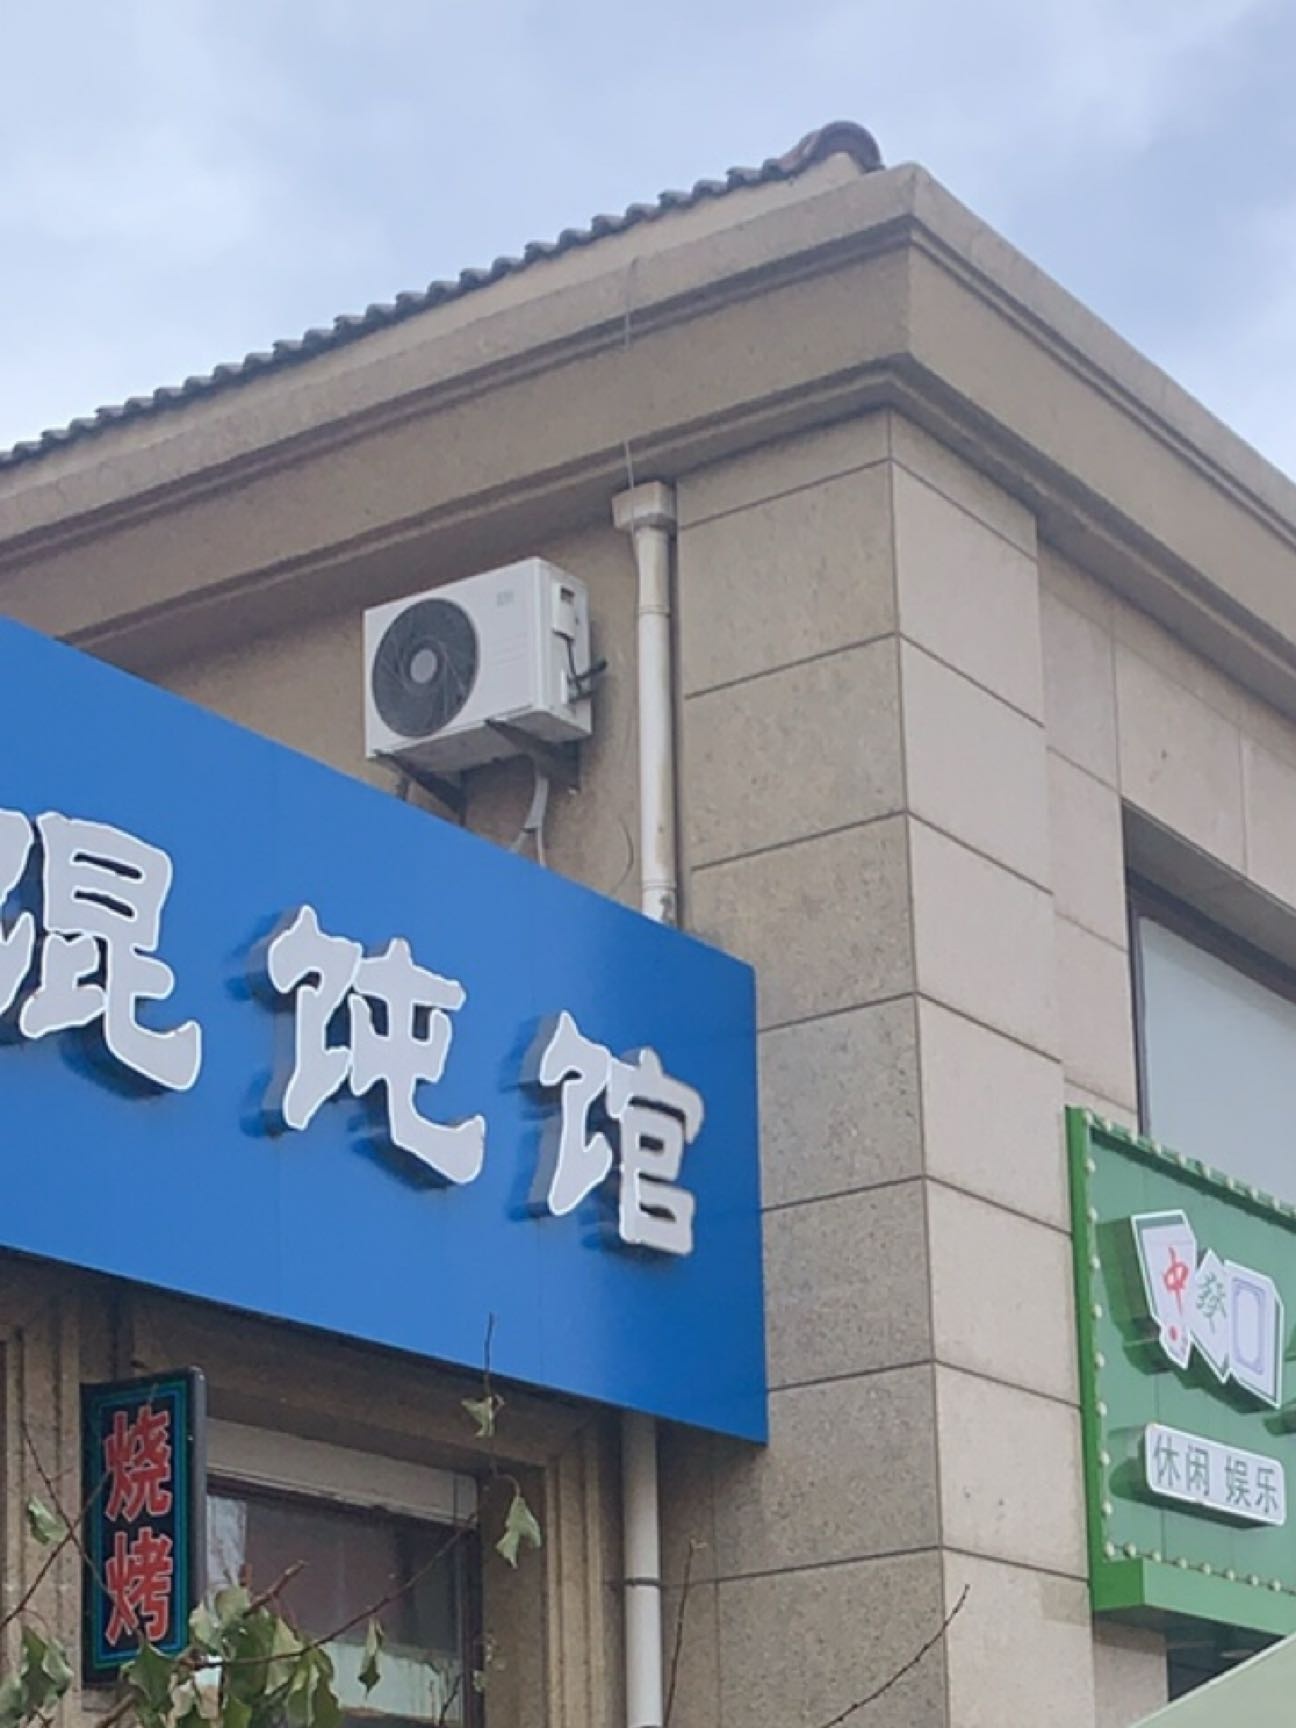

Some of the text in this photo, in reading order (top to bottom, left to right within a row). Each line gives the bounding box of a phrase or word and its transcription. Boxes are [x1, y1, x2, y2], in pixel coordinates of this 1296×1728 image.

[104, 1404, 173, 1647] 烧烤
[1154, 1434, 1279, 1514] 休闲 娱乐
